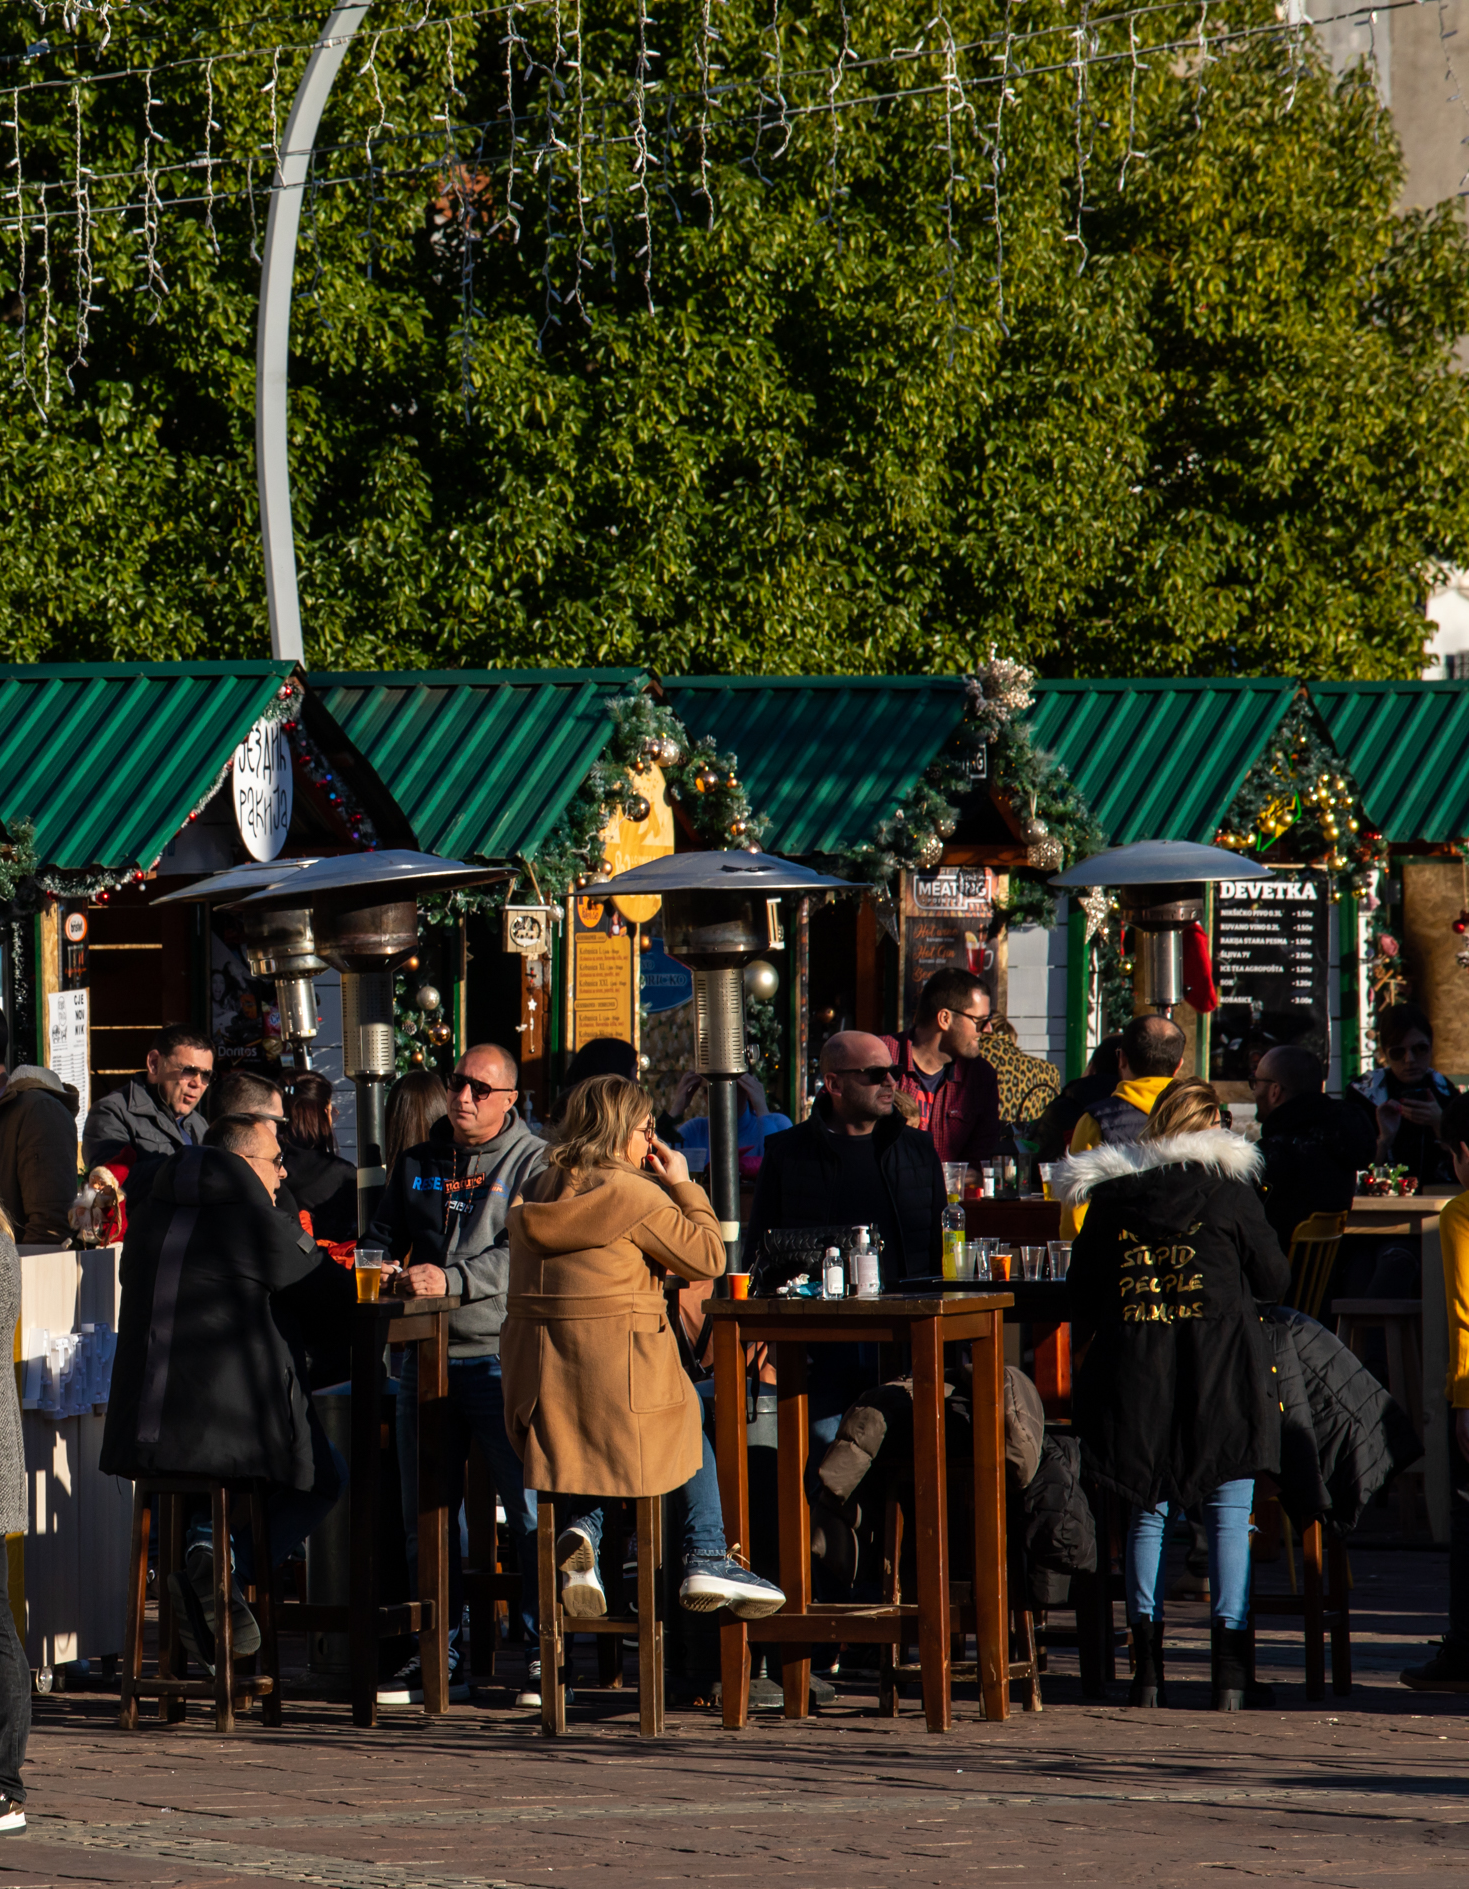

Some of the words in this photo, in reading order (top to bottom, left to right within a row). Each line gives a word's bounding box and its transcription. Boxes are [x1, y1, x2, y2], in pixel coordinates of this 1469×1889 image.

[1220, 882, 1317, 899] DEVETKA
[218, 1046, 257, 1057] Doritos
[445, 1177, 483, 1191] nature
[1120, 1245, 1196, 1269] STUPID
[1119, 1273, 1203, 1297] PEOPLE
